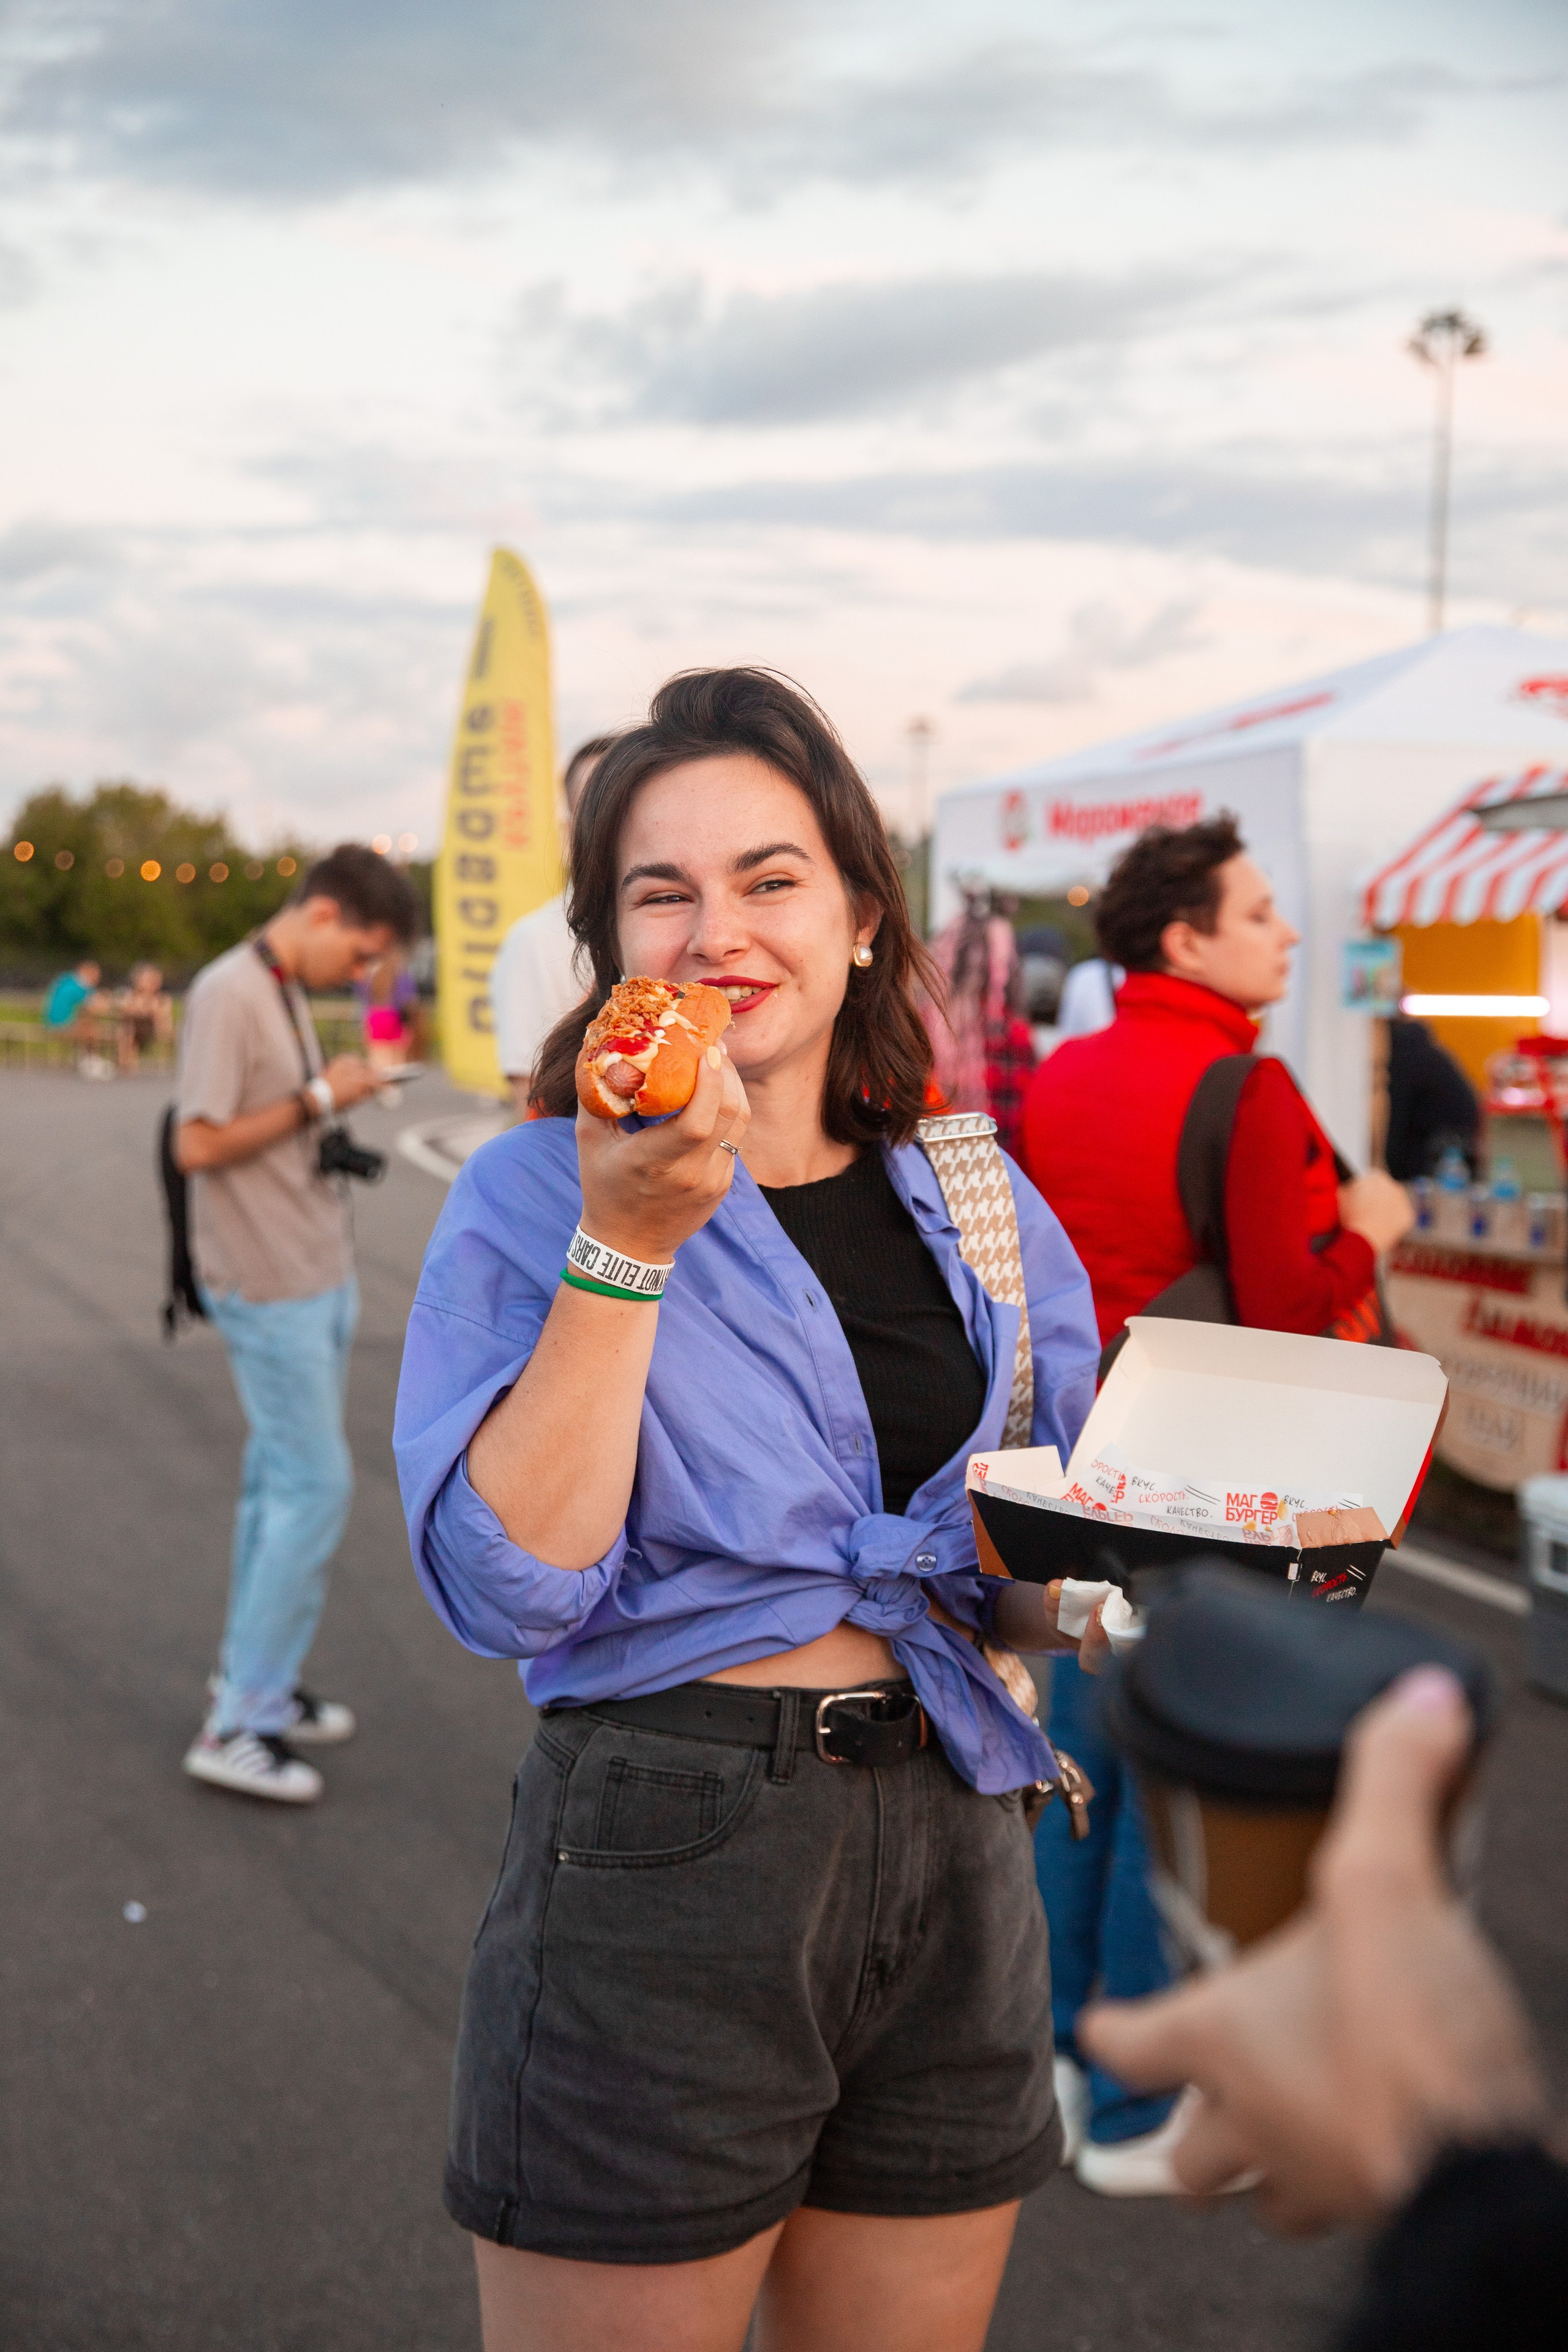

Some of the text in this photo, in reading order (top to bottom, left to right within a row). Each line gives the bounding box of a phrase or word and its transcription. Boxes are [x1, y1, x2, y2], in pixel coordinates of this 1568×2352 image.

[571, 1235, 601, 1270] CARS
[597, 1252, 641, 1287] ELITE
[636, 1268, 663, 1291] NOT
[1096, 1476, 1117, 1494] КАЧЕ
[1131, 1476, 1158, 1493] ВКУС.
[1139, 1491, 1189, 1503] СКОРОСТЬ.
[1226, 1493, 1257, 1509] МАГ
[1284, 1494, 1308, 1510] ВКУС.
[1167, 1506, 1213, 1518] КАЧЕСТВО.
[1226, 1507, 1278, 1525] БУРГЕР
